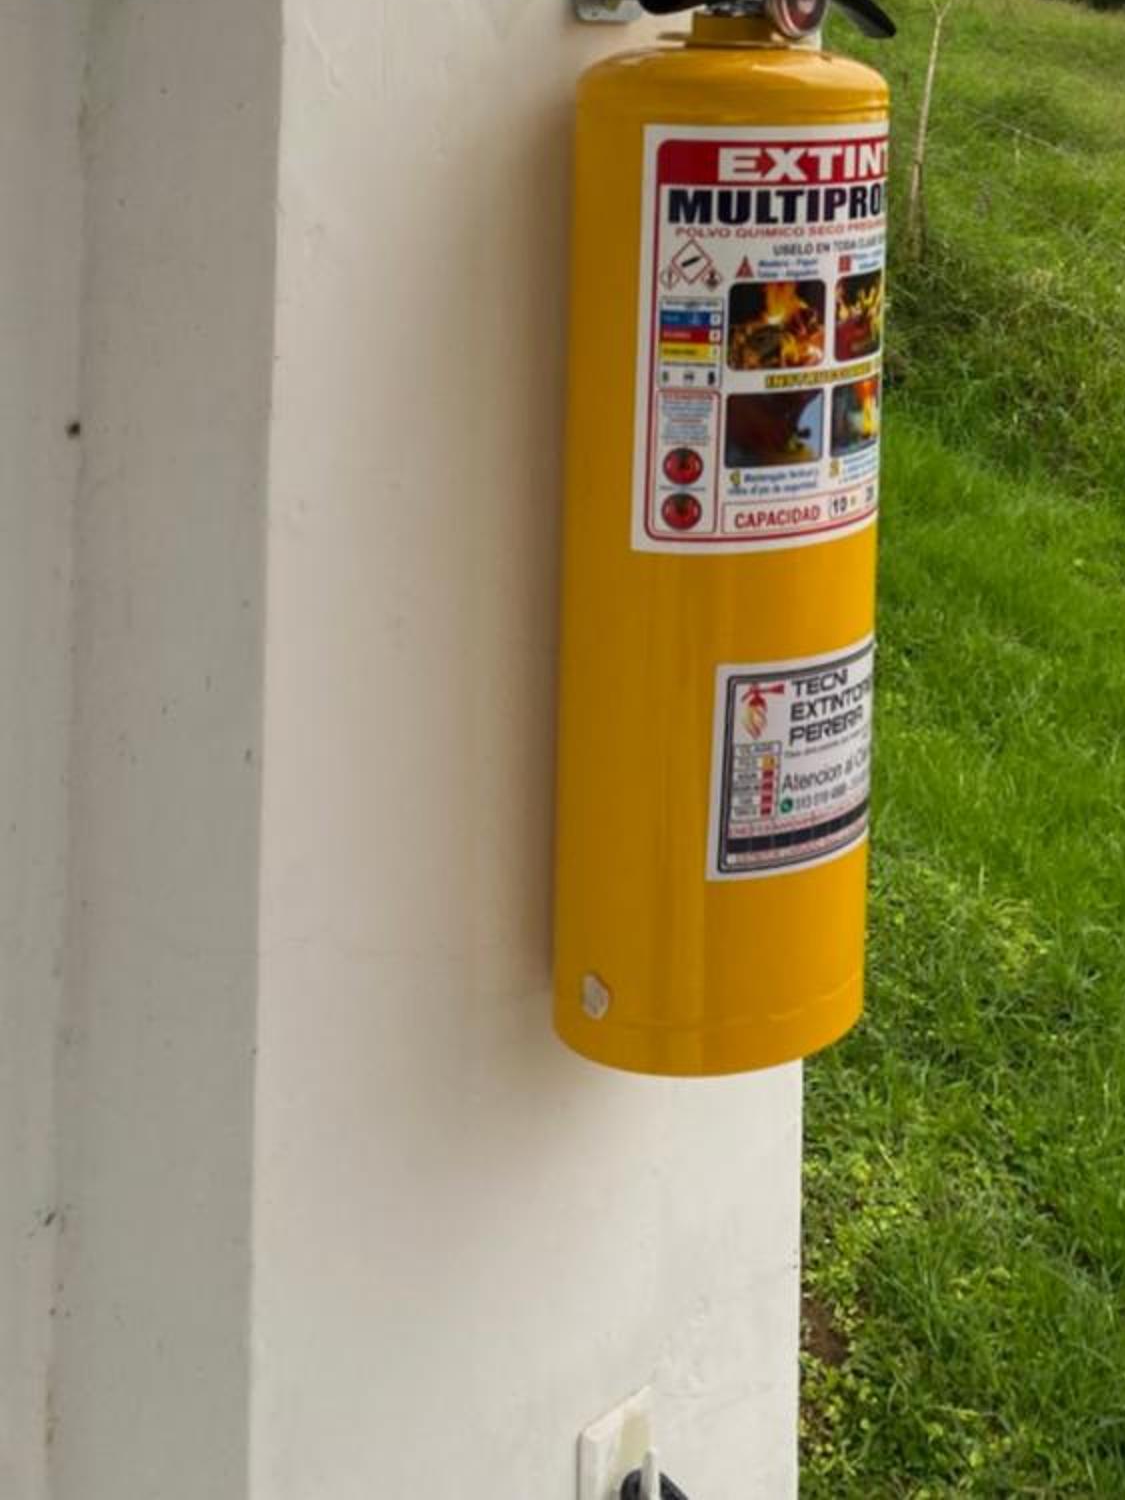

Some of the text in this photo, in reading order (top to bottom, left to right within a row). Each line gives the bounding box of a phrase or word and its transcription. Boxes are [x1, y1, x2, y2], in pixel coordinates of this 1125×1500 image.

[675, 227, 731, 239] POLVO
[808, 224, 844, 236] SECO
[735, 505, 821, 528] CAPACIDAD
